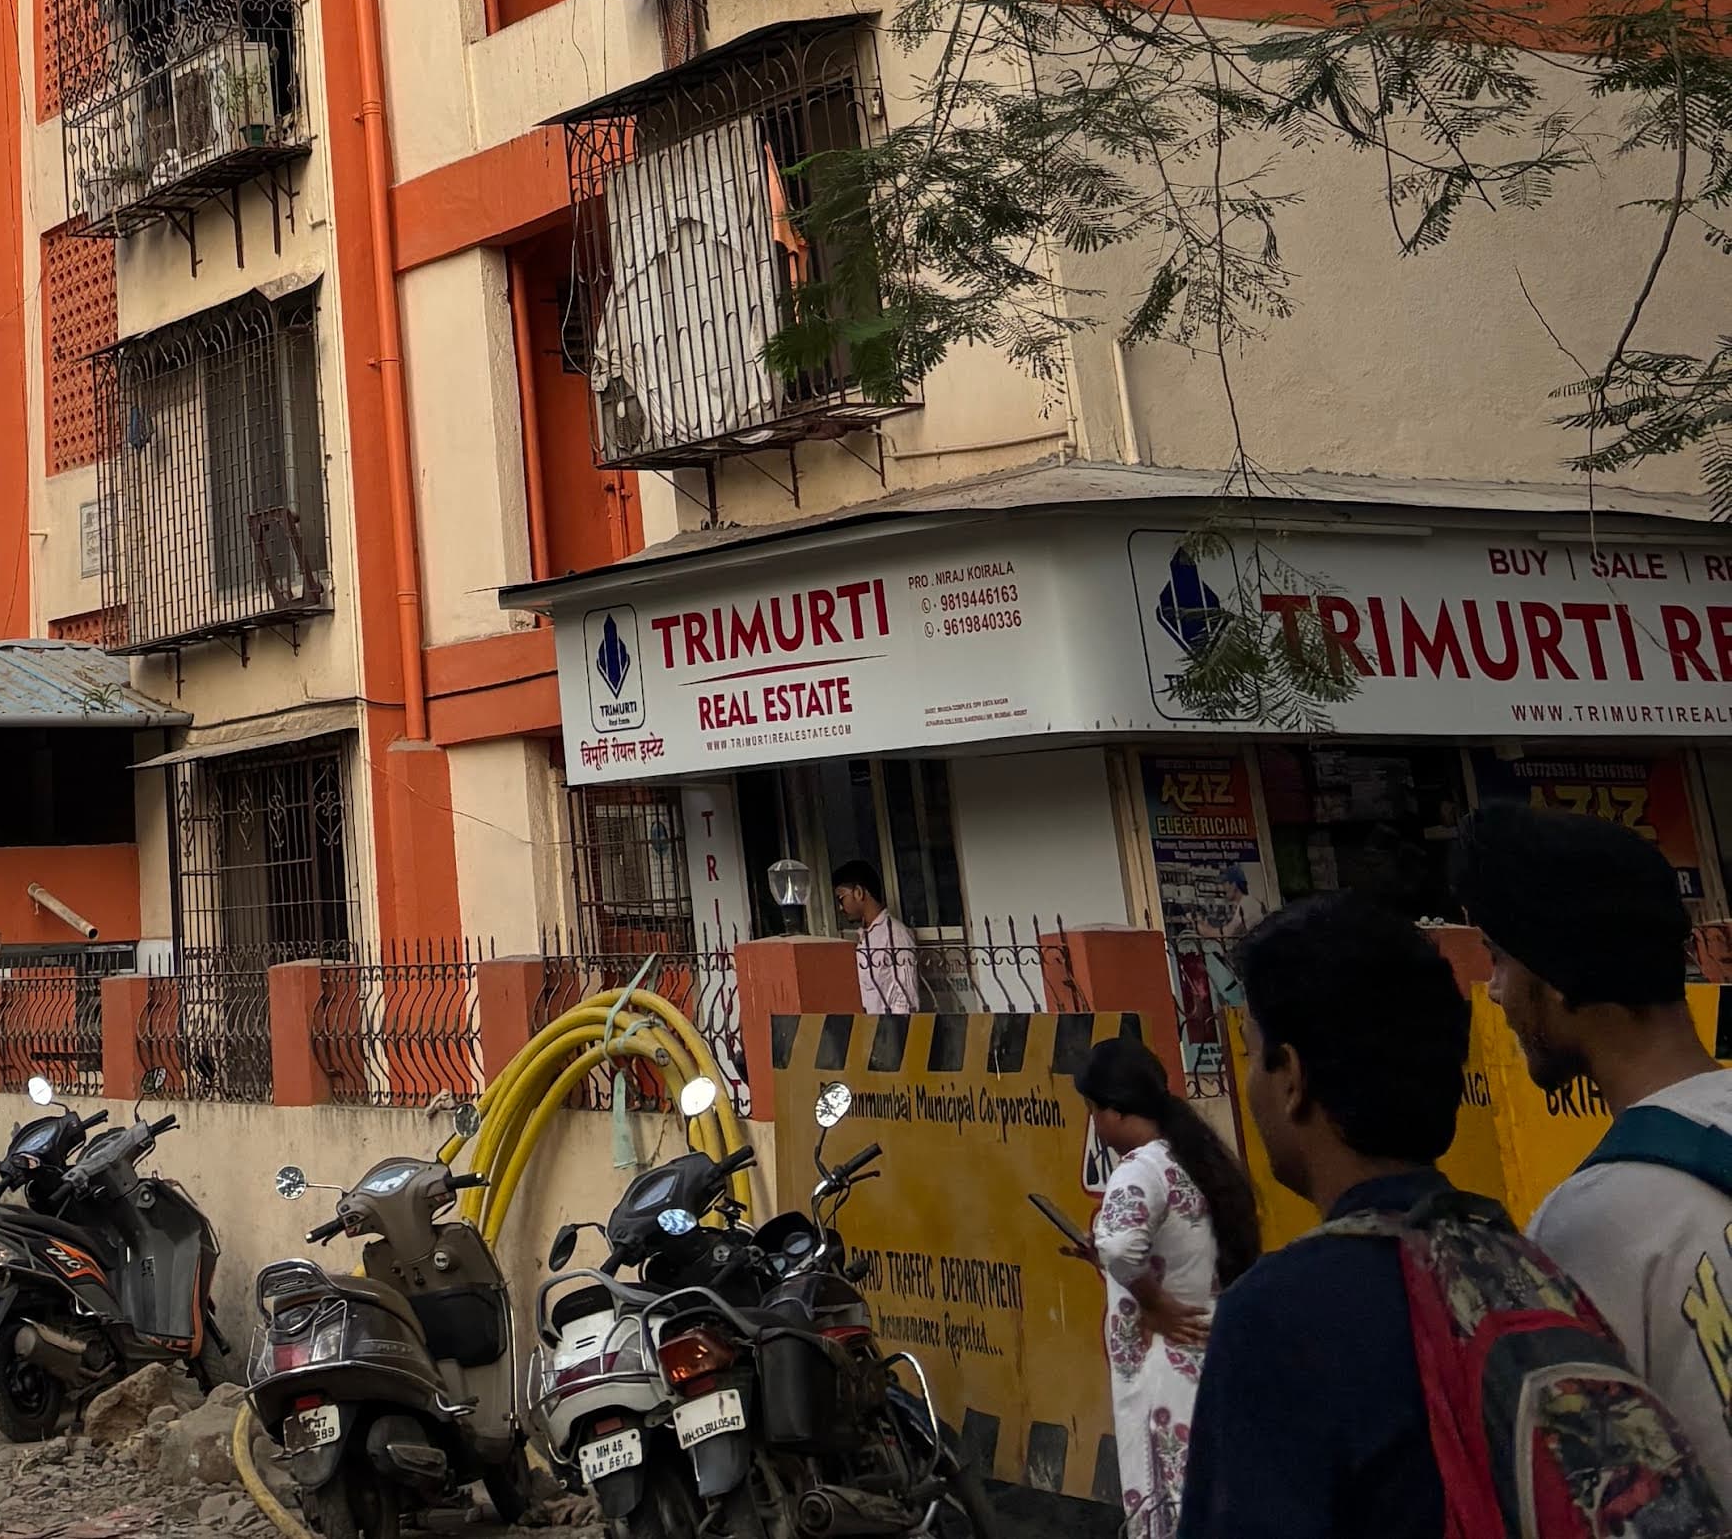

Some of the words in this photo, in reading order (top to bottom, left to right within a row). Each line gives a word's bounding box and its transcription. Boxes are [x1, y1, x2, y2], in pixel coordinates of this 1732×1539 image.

[967, 561, 1015, 581] KOIRALA
[1488, 548, 1548, 576] BUY
[1590, 552, 1667, 580] SALE
[940, 584, 1019, 612] 9819446163
[651, 578, 890, 669] TRIMURTI
[943, 610, 1022, 636] 9619840336
[1260, 594, 1644, 682] TRIMURTI
[600, 701, 637, 718] TRIMURTI
[698, 689, 758, 731] REAL
[762, 677, 854, 723] ESTATE
[1511, 705, 1732, 723] WWW.TRIMURTIREAL
[580, 738, 609, 771] त्रिमूर्ति
[611, 737, 637, 762] रीयल
[1161, 773, 1235, 813] AZIZ
[1156, 815, 1249, 835] ELECTRICIAN
[916, 1081, 975, 1136] Municipal
[885, 1250, 935, 1302] TRAFFIC
[939, 1255, 1024, 1312] DEPARTMENT
